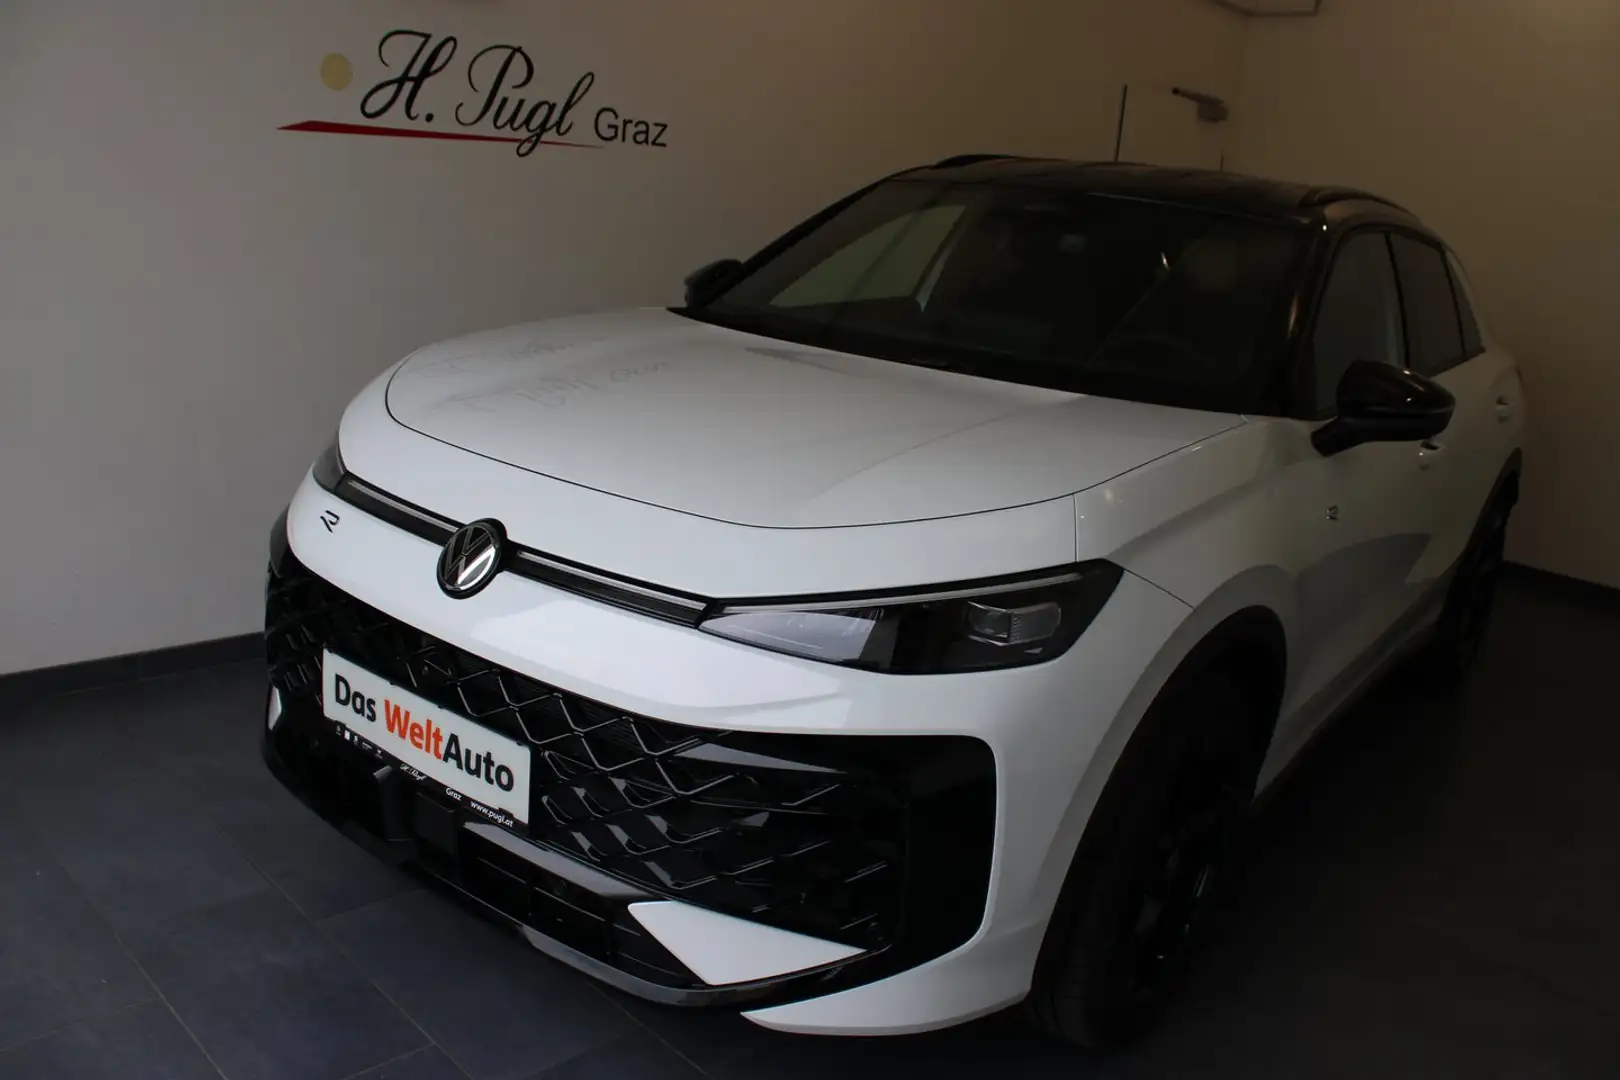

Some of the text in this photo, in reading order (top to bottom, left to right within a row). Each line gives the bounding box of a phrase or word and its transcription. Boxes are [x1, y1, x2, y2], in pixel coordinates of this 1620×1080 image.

[360, 30, 668, 157] H. Pugl Graz
[335, 674, 376, 722] Das
[384, 699, 514, 792] WeltAuto
[446, 787, 462, 801] Graz
[470, 801, 514, 828] www.pugl.at
